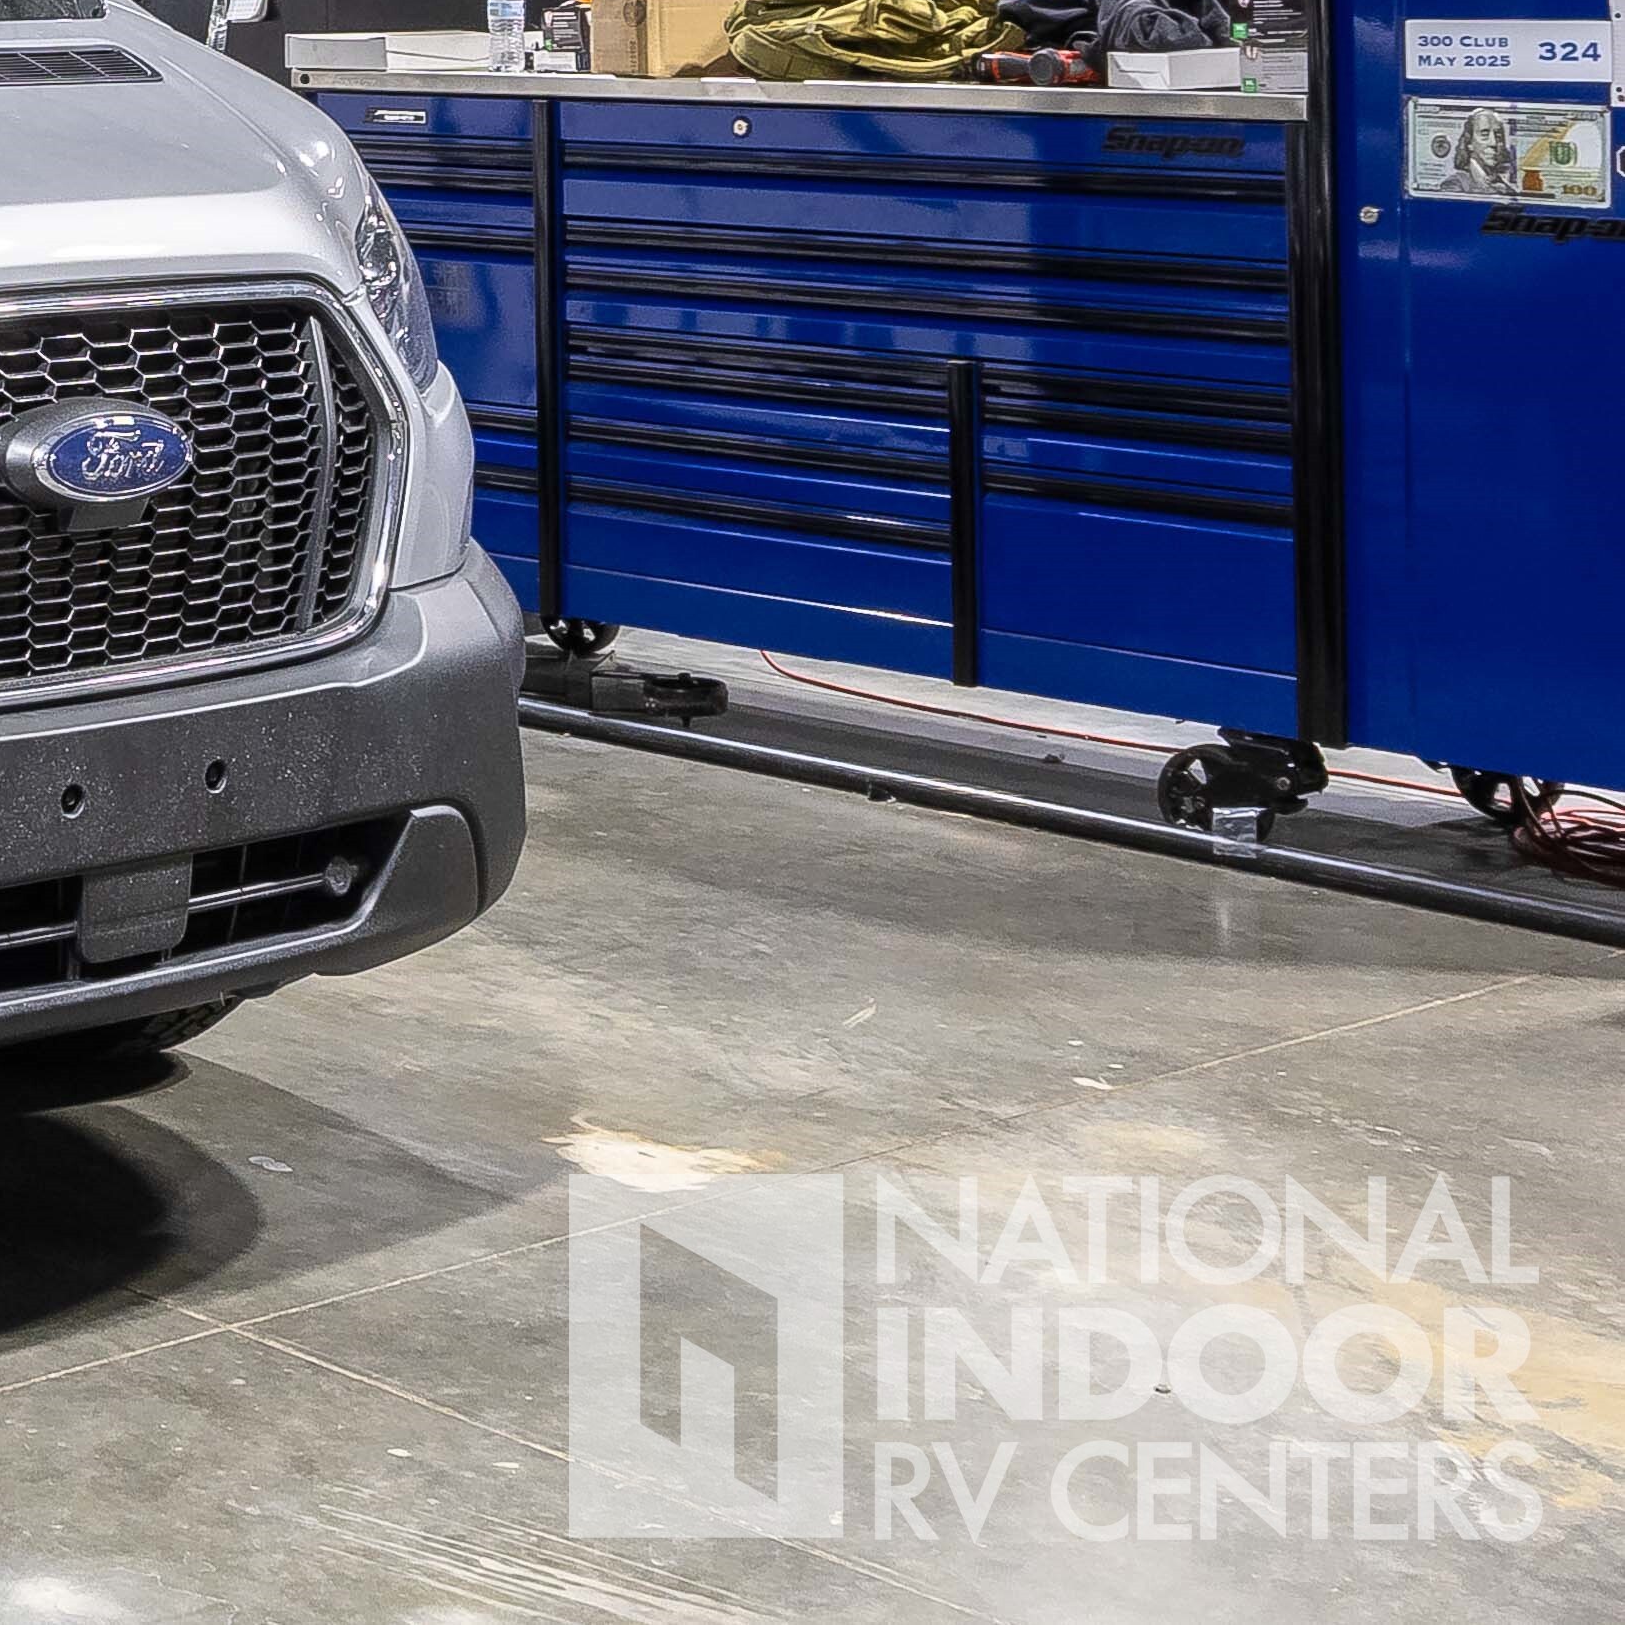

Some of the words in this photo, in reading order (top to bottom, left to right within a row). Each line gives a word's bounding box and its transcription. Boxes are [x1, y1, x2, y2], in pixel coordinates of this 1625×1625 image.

[1417, 35, 1454, 48] 300
[1537, 41, 1603, 63] 324
[1463, 54, 1512, 68] 2025
[1480, 205, 1625, 244] Snap-o
[80, 428, 166, 482] Ford
